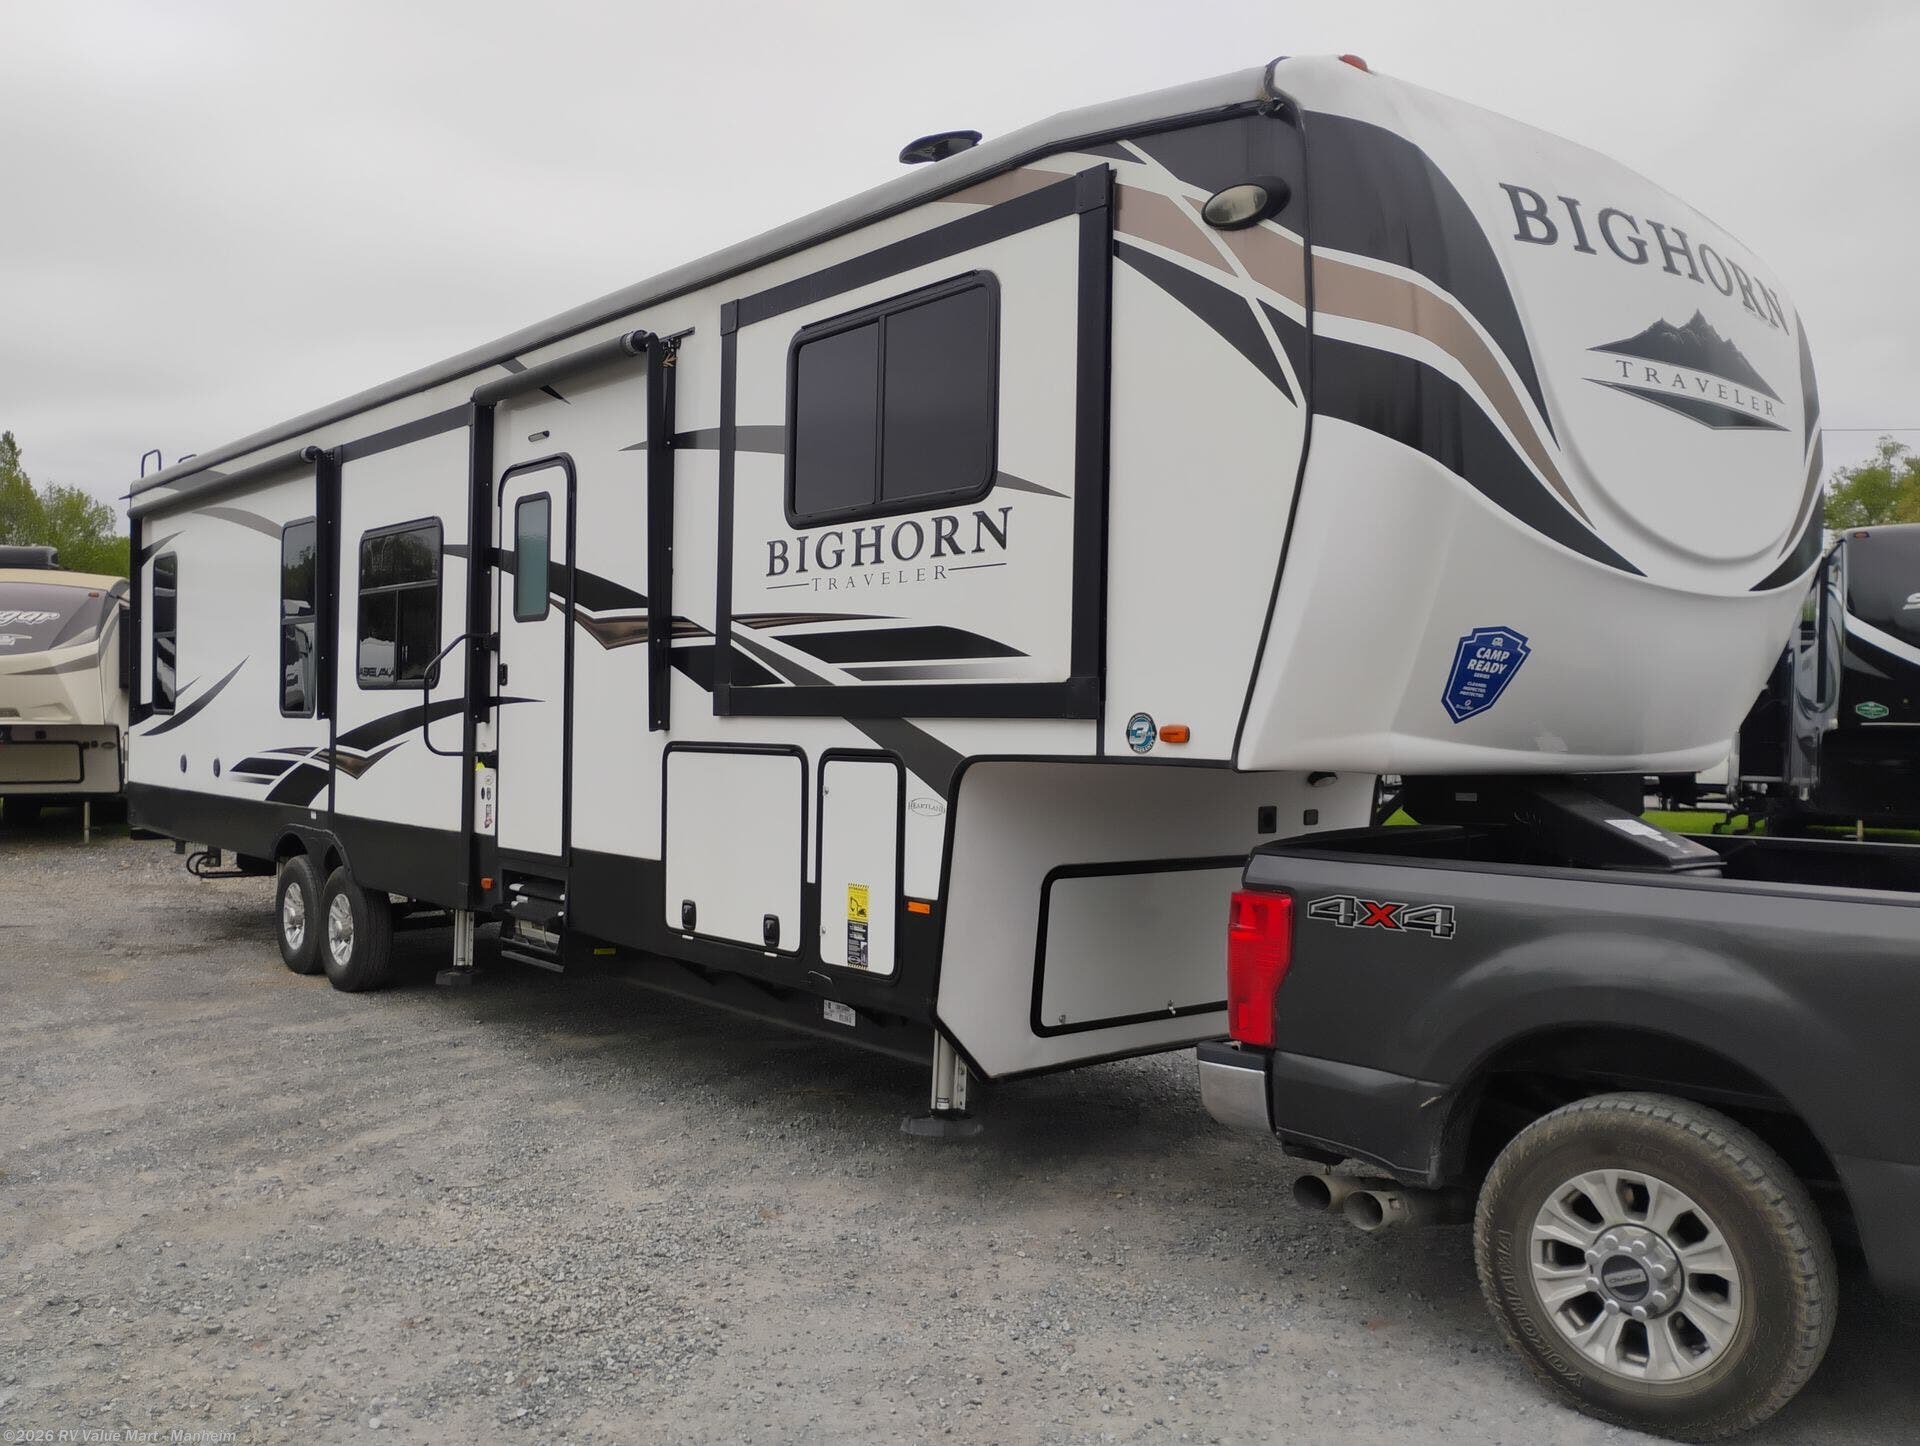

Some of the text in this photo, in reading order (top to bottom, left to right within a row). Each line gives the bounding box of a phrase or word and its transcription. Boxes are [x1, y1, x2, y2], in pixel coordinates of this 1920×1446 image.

[1499, 183, 1790, 337] BIGHORN
[1615, 359, 1776, 418] TRAVELER
[766, 506, 1013, 578] BIGHORN
[811, 564, 948, 592] TRAVELER
[1467, 658, 1508, 674] READY
[1476, 647, 1510, 662] CAMP
